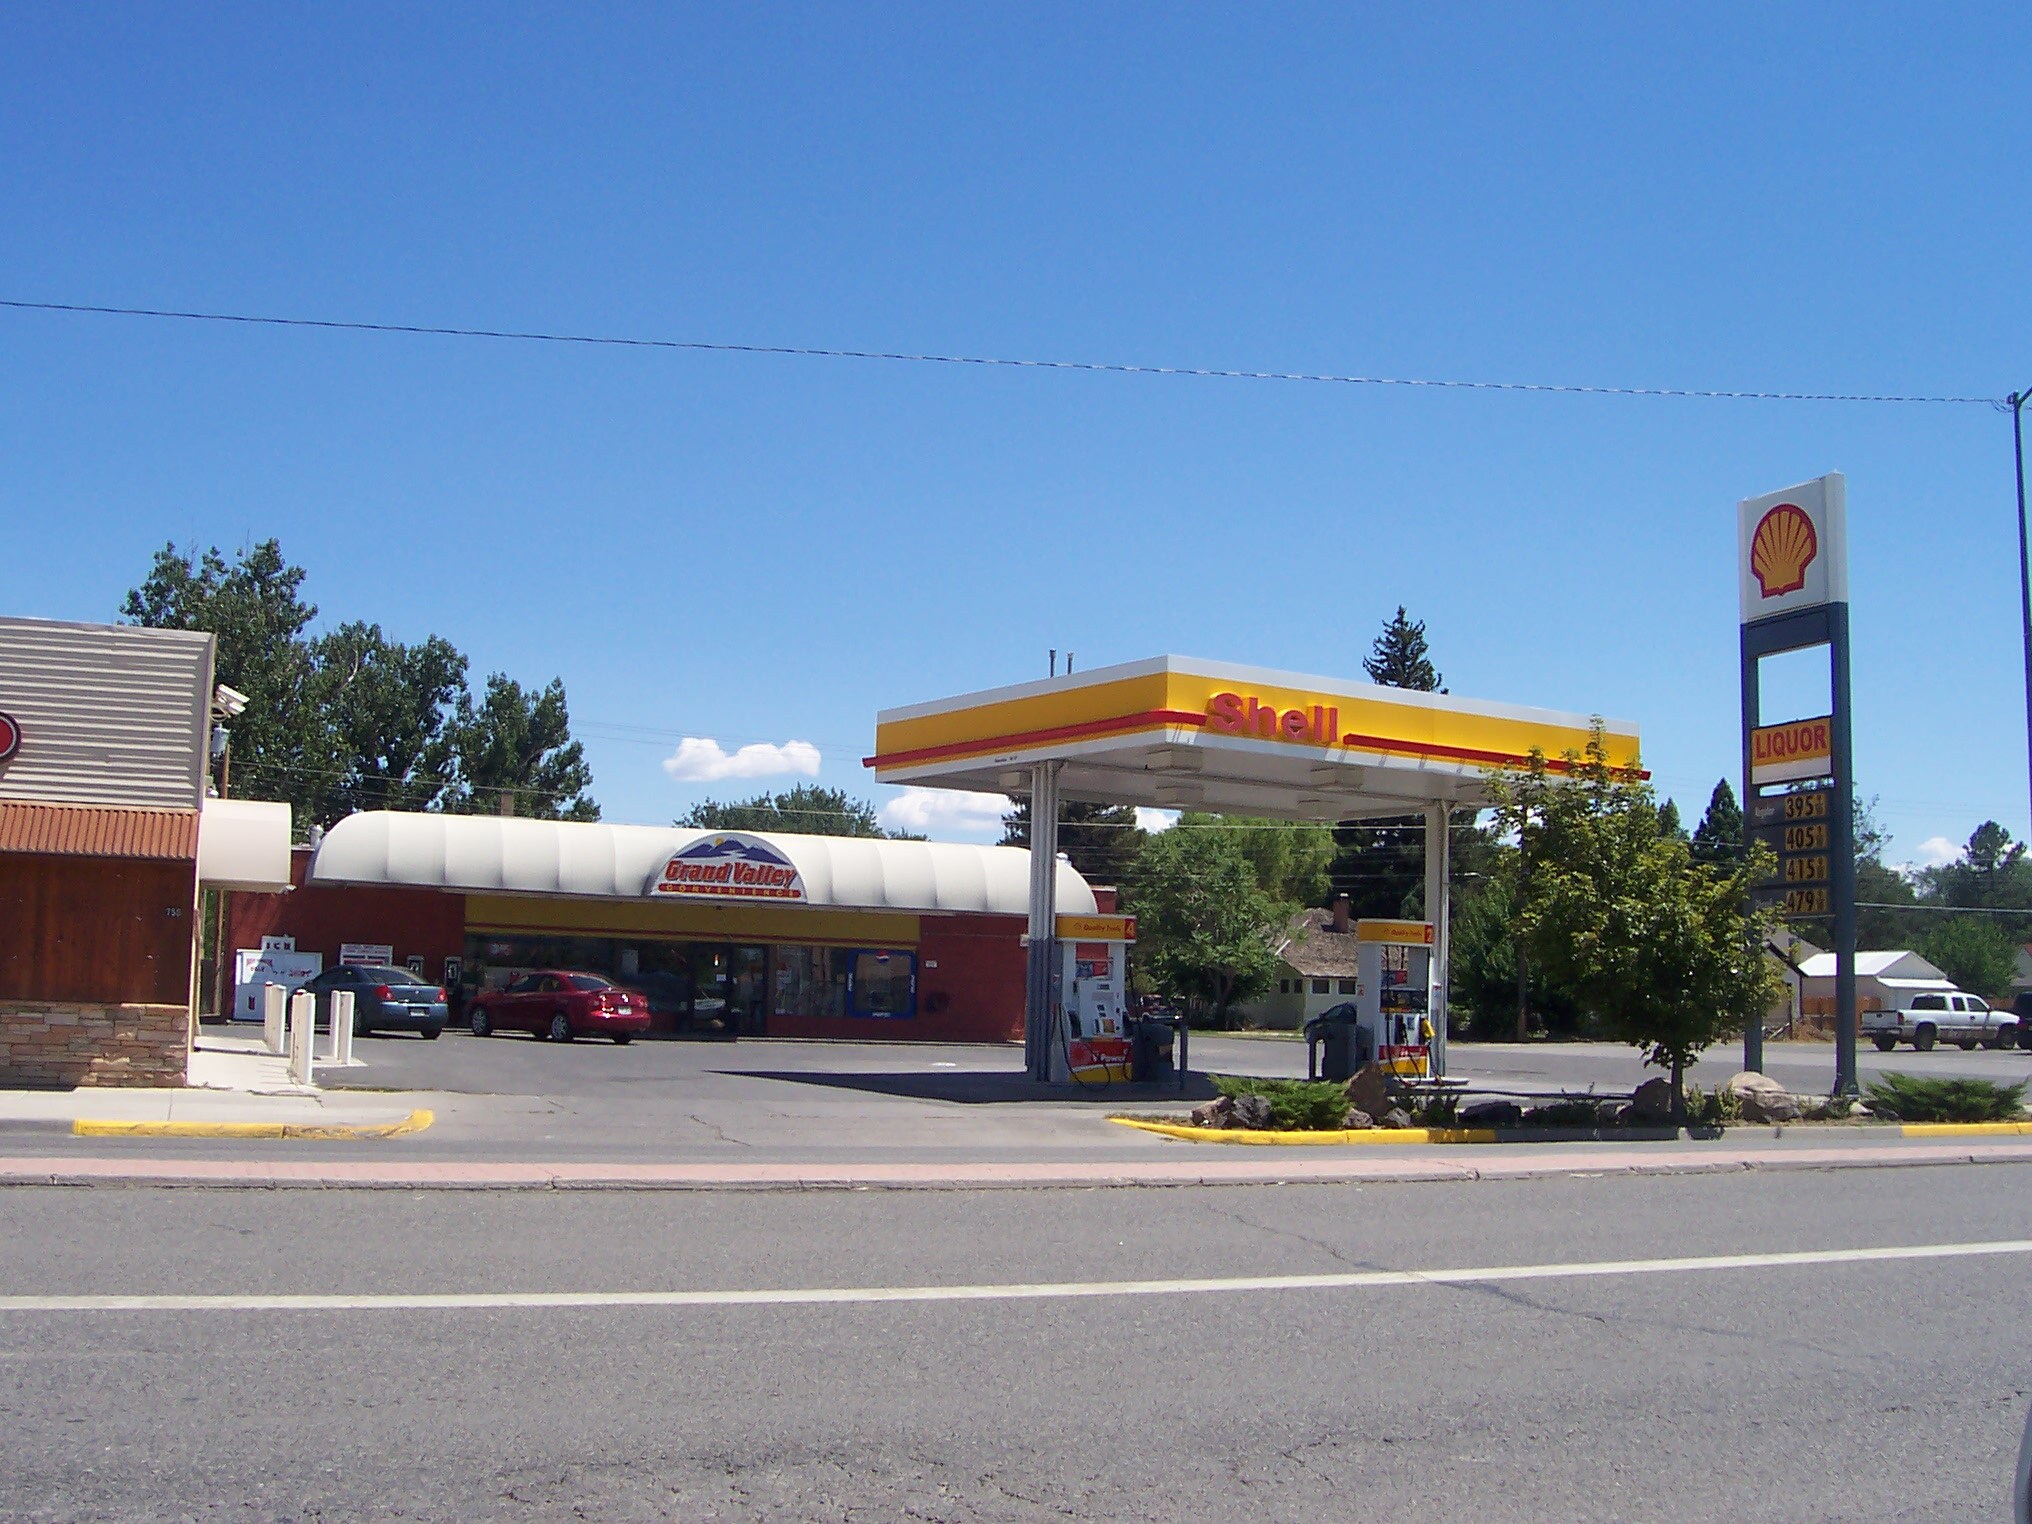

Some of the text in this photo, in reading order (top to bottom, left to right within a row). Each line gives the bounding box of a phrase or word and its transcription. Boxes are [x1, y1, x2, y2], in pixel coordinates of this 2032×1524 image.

[1208, 692, 1338, 743] Shell
[1755, 724, 1827, 759] LIQUOR
[665, 860, 798, 888] Grand Valley
[666, 884, 794, 897] CONVENIENCE
